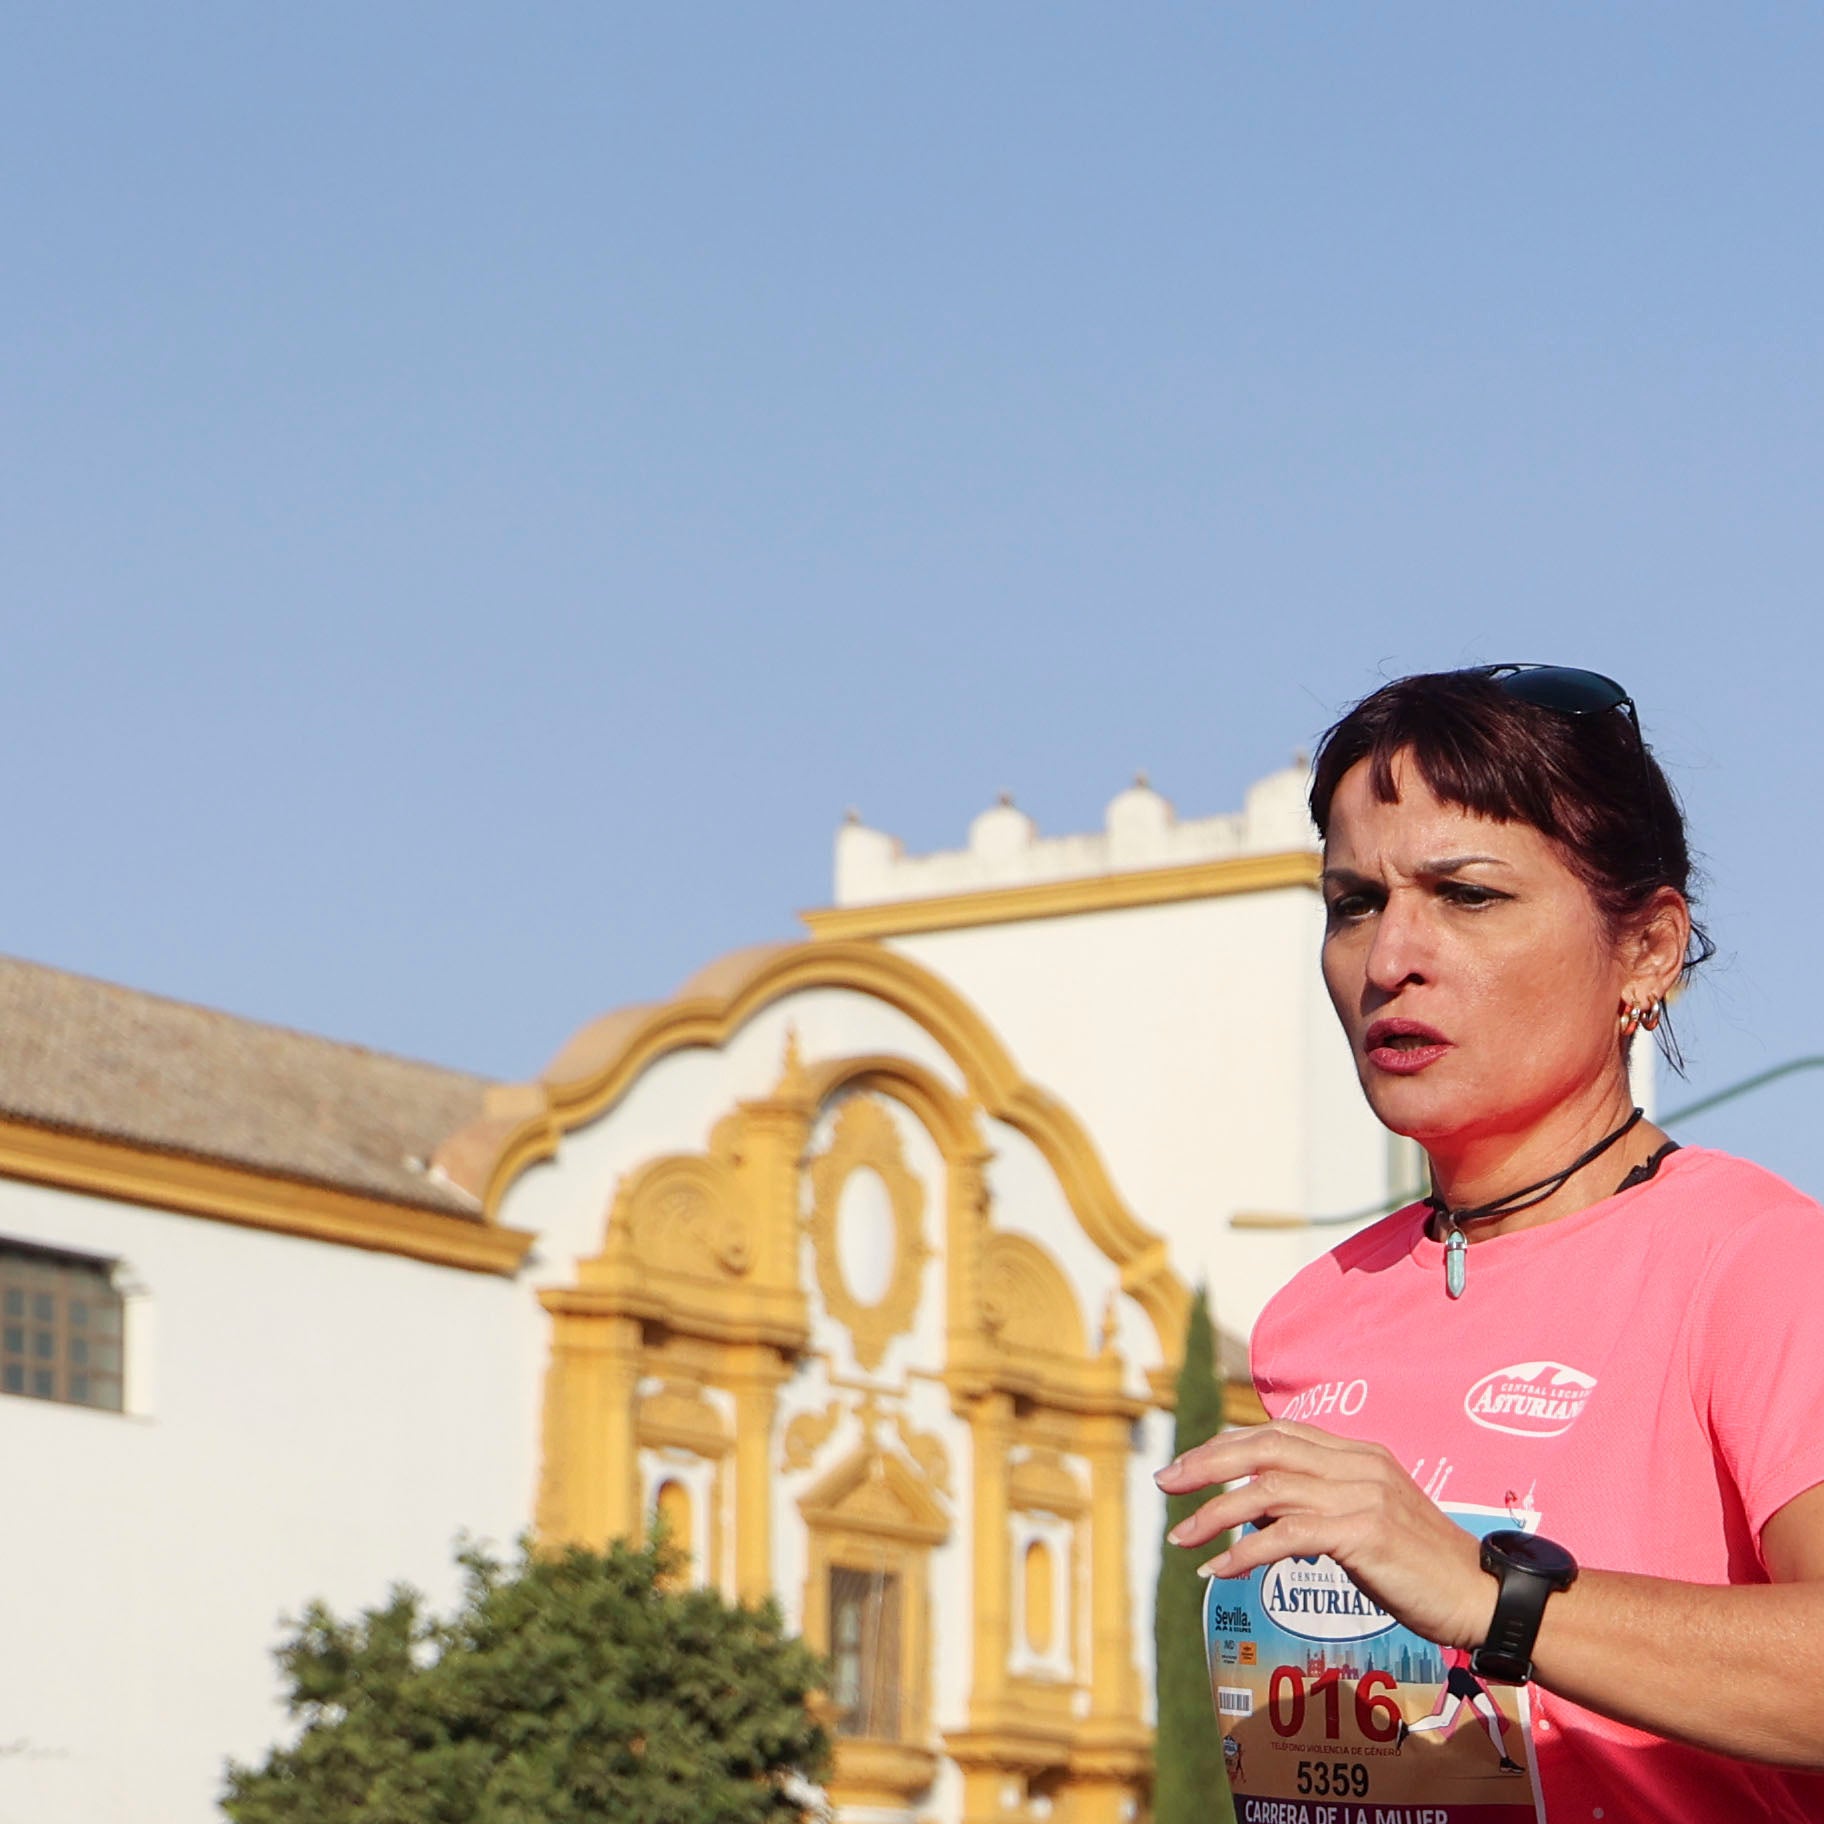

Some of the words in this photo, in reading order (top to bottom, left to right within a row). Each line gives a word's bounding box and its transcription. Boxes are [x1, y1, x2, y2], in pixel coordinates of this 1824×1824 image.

[1501, 1383, 1546, 1396] CENTRAL
[1290, 1571, 1335, 1583] CENTRAL
[1269, 1665, 1402, 1743] 016
[1352, 1746, 1363, 1755] DE
[1297, 1760, 1369, 1798] 5359
